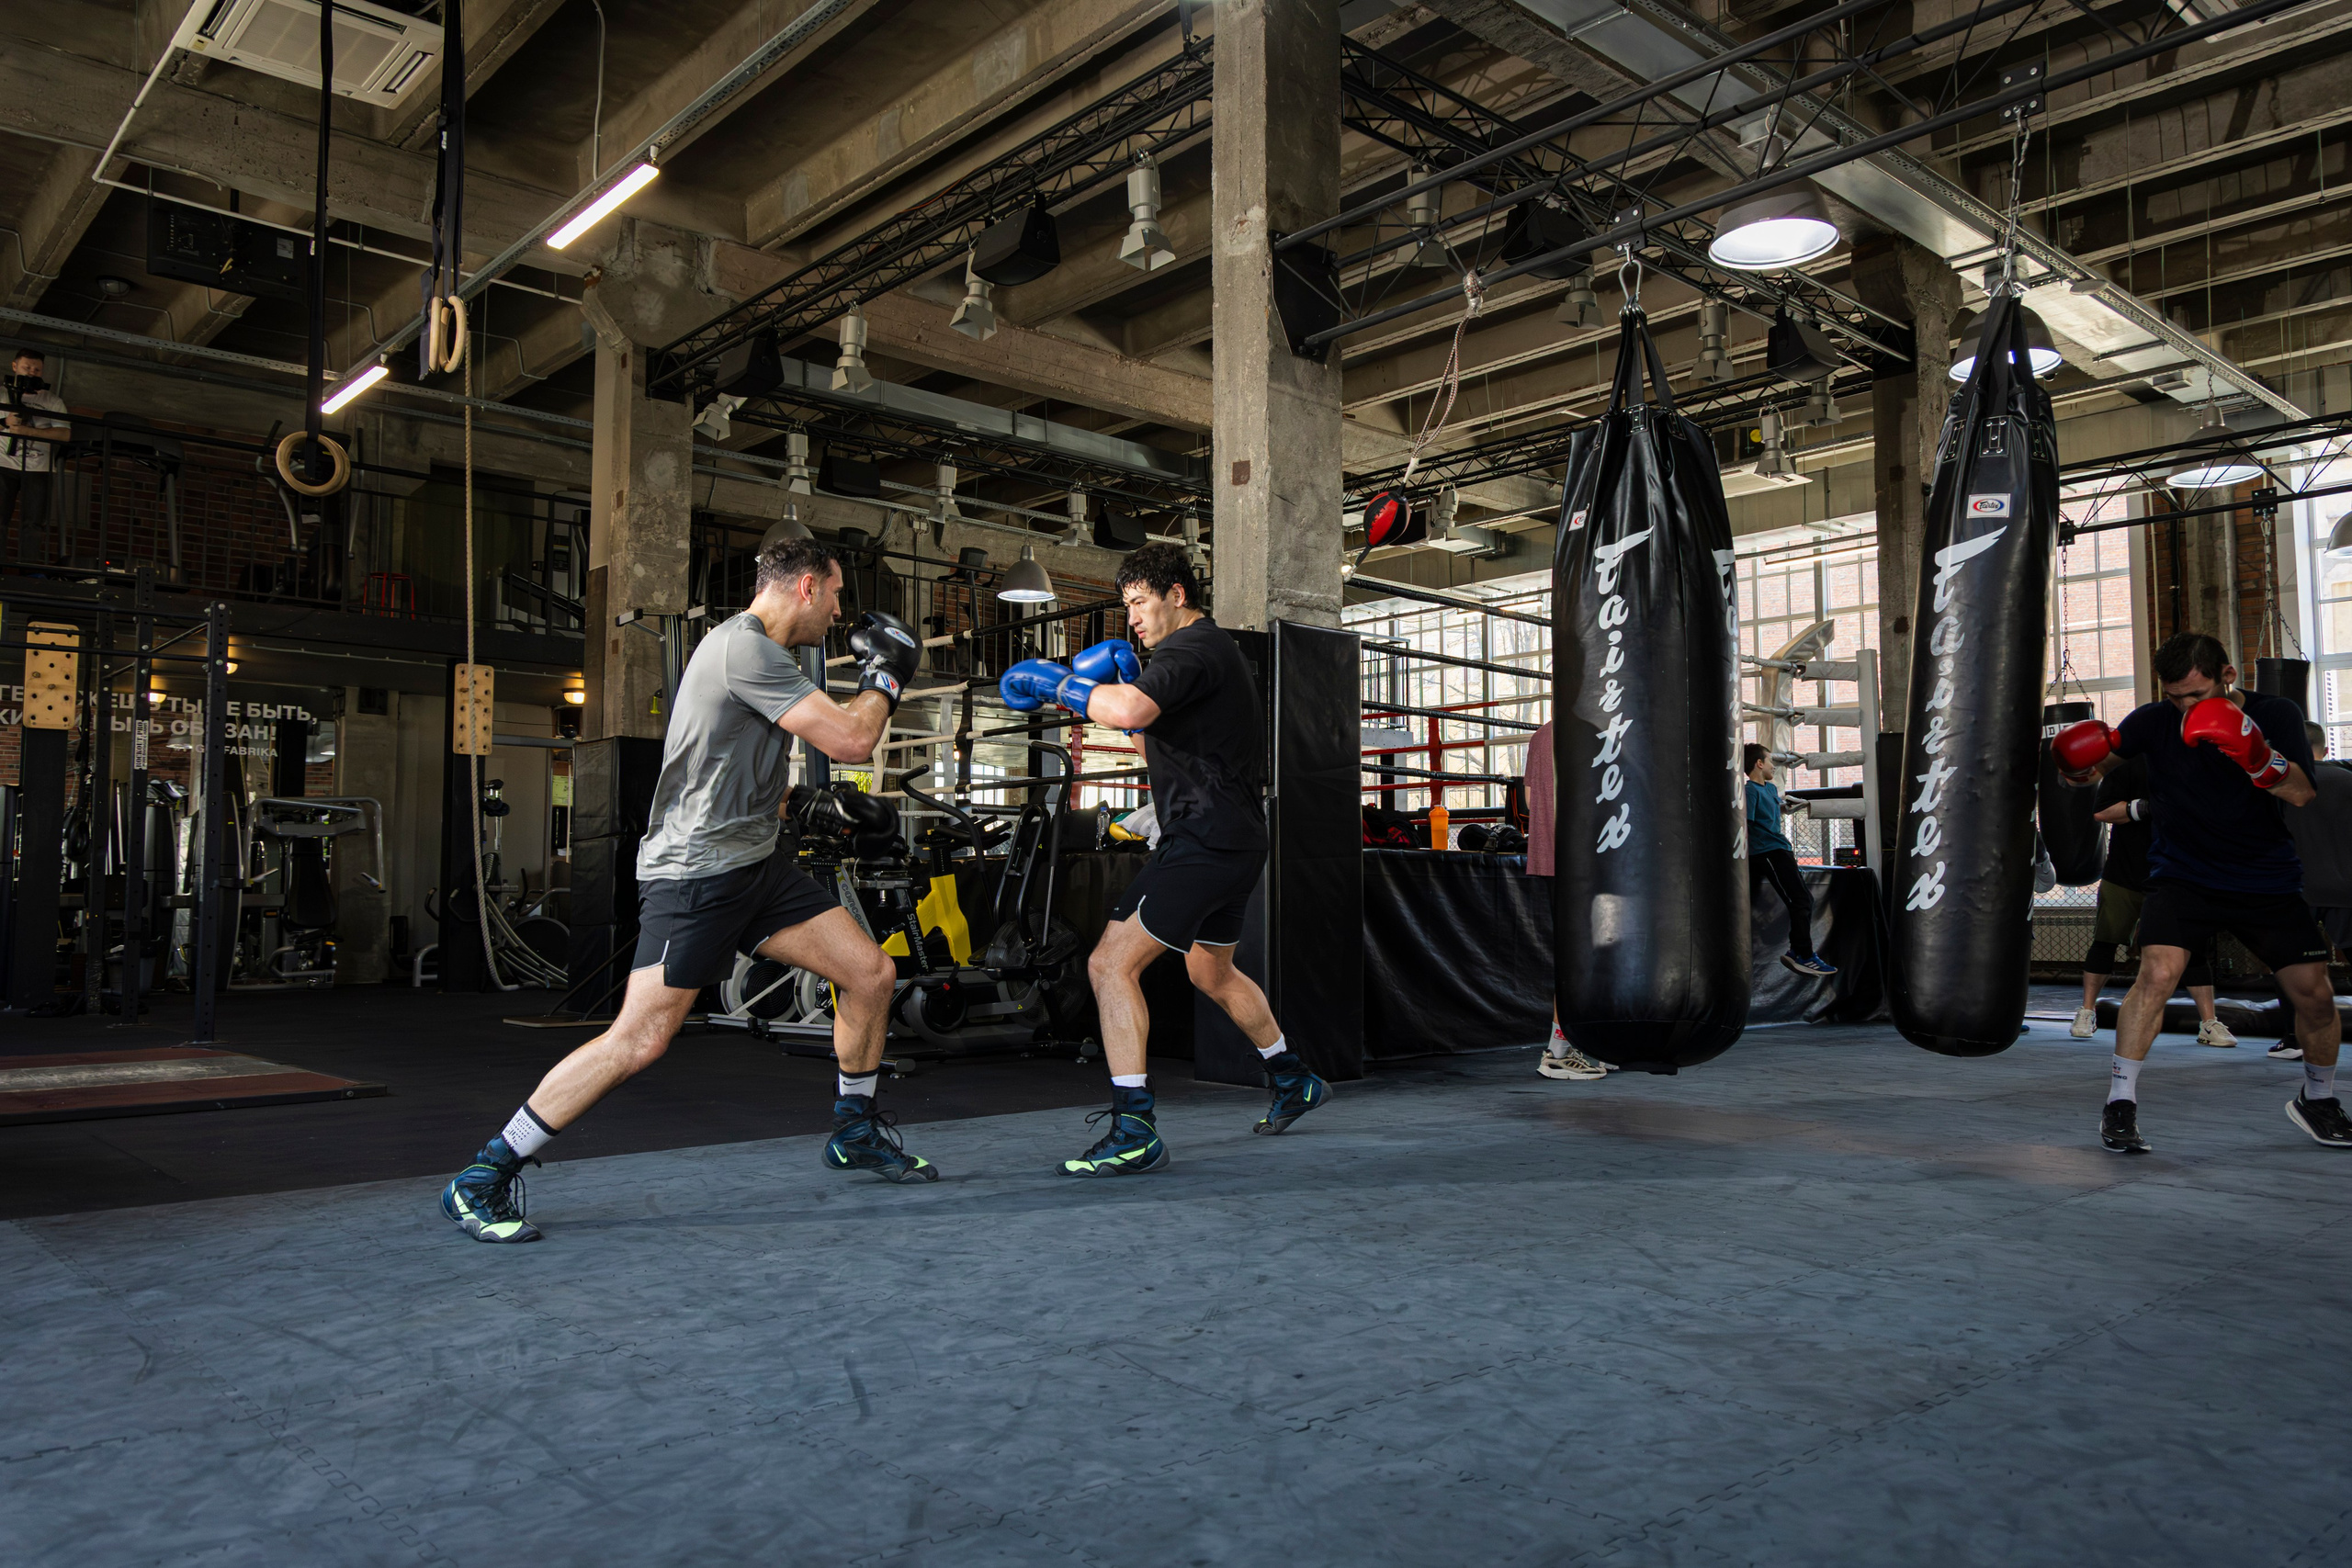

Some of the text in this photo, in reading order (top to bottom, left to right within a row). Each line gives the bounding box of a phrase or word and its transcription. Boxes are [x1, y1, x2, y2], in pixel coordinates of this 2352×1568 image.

[166, 696, 202, 714] ТЫ
[226, 701, 241, 716] Е
[246, 703, 318, 725] БЫТЬ,
[1591, 525, 1655, 854] Fairtex
[1905, 525, 2007, 911] Fairtex
[170, 719, 277, 741] ОБЗАН!
[907, 913, 929, 970] StairMaster
